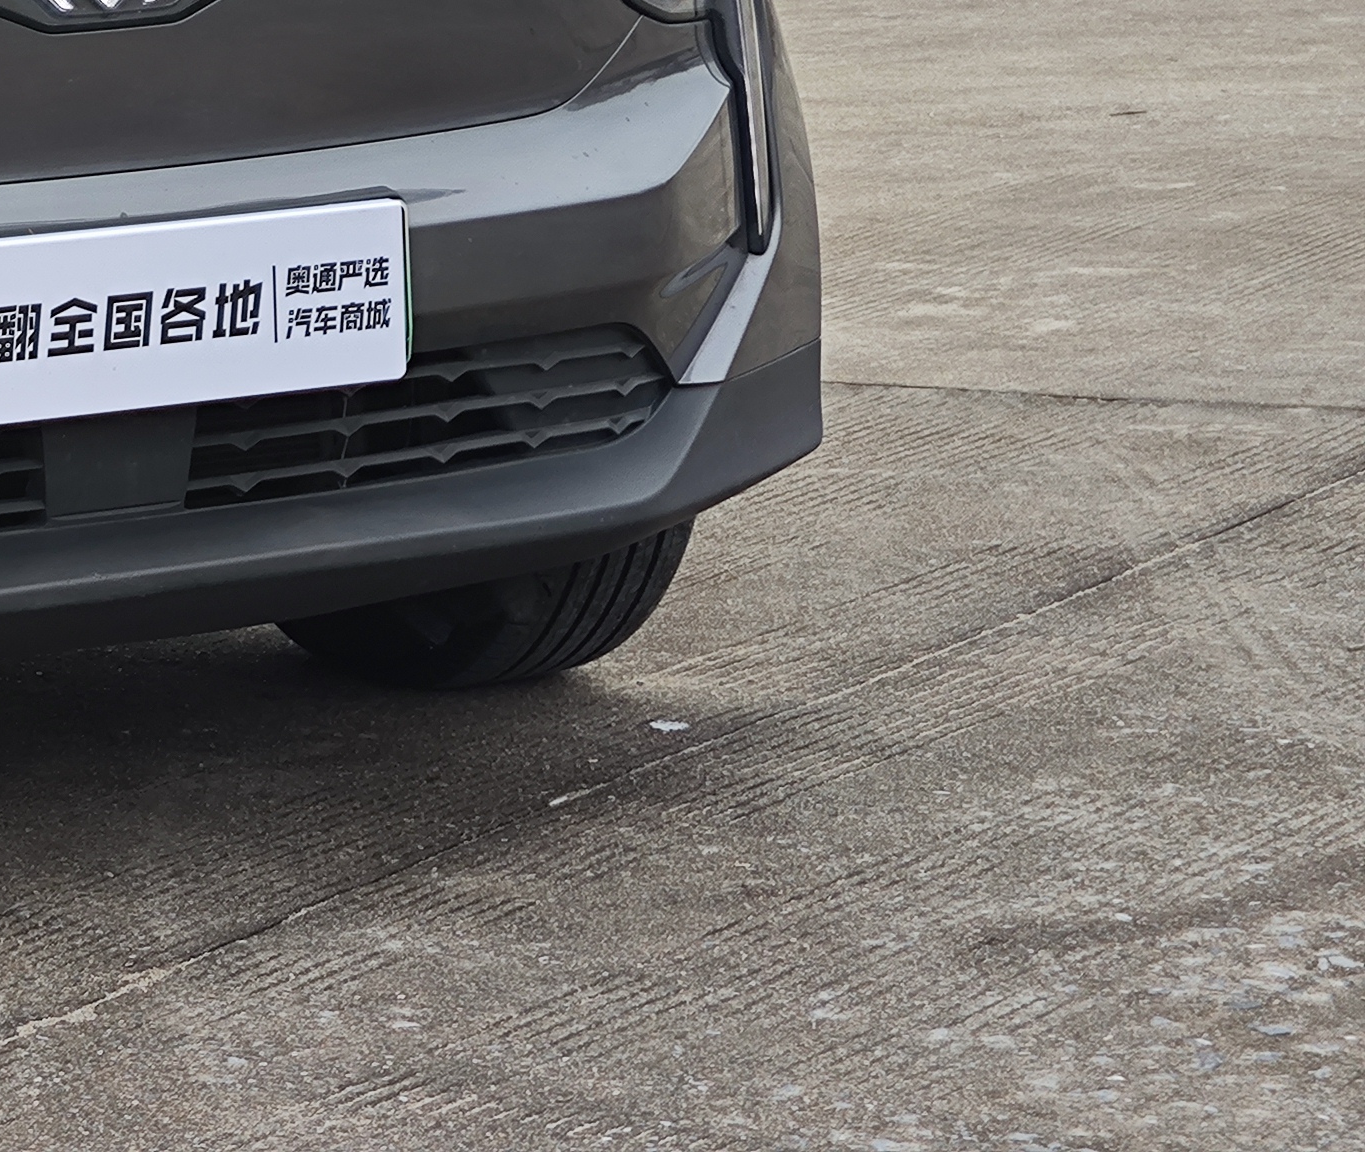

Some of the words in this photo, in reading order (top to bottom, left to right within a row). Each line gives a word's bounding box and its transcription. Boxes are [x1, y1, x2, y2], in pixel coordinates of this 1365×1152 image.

[285, 256, 390, 297] 奥通严选
[286, 298, 392, 339] 汽车商城
